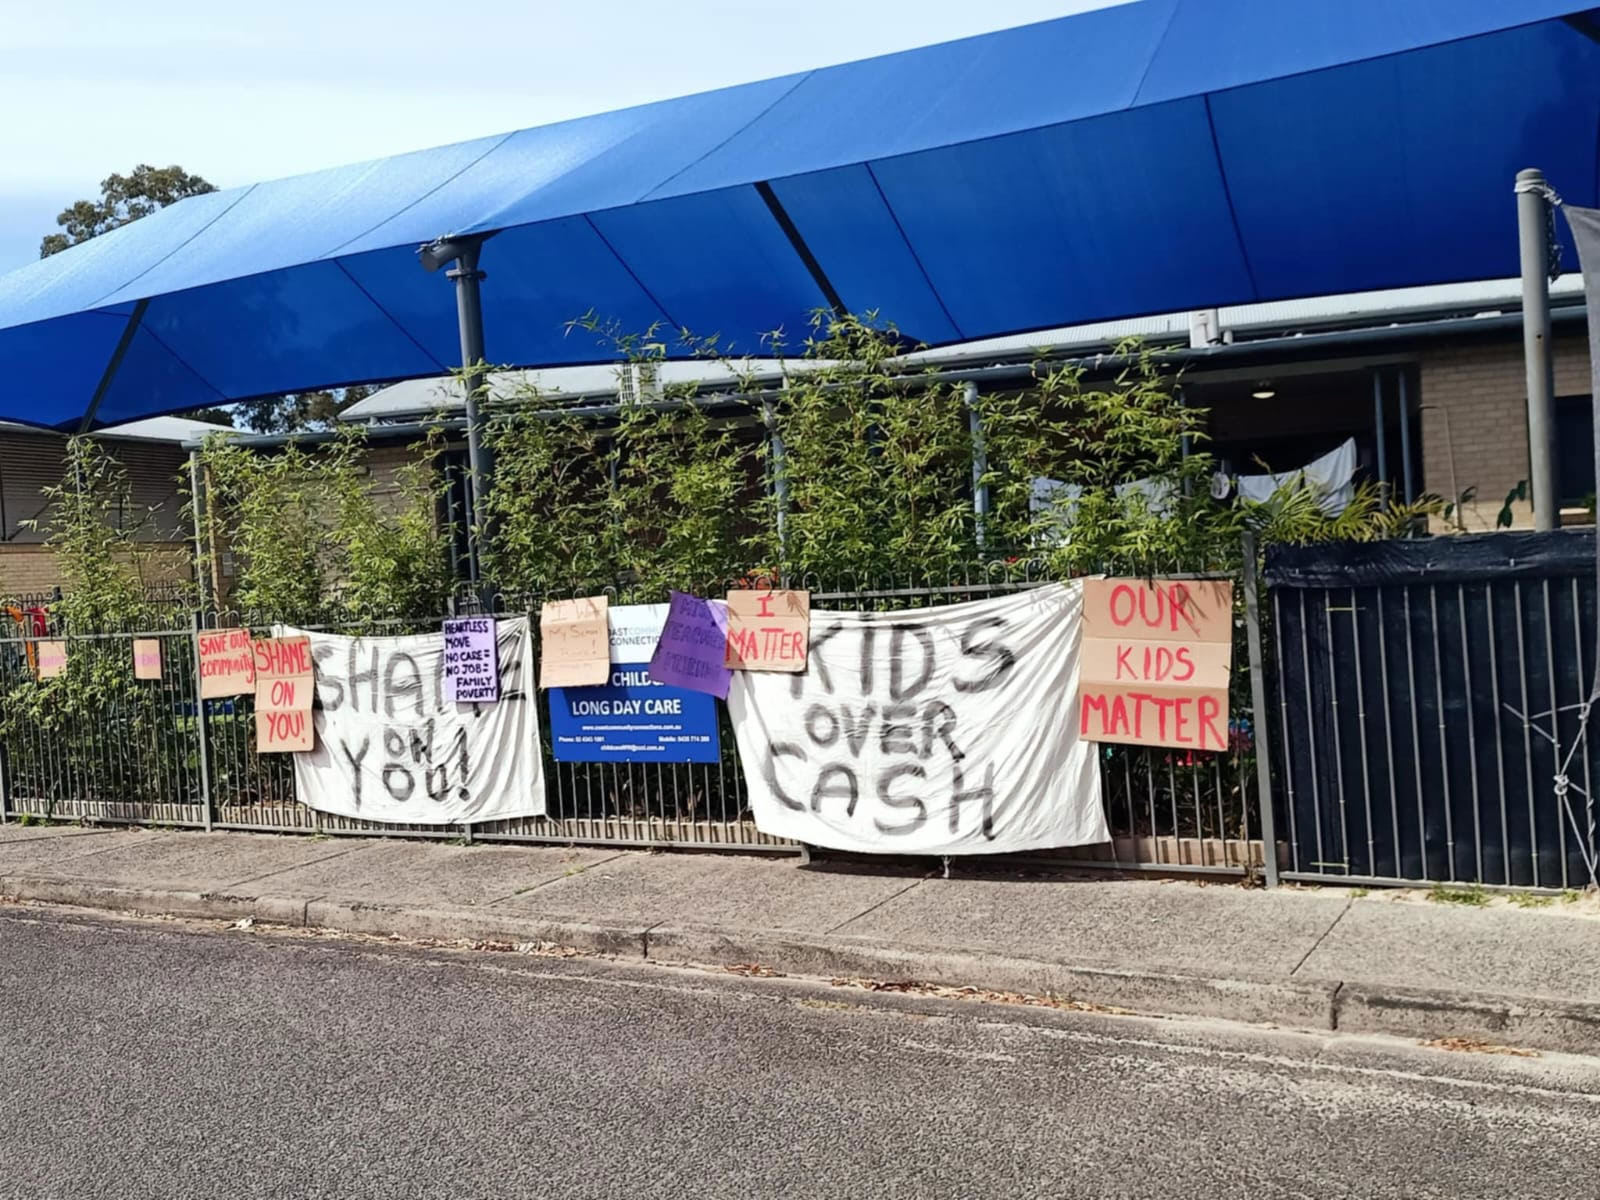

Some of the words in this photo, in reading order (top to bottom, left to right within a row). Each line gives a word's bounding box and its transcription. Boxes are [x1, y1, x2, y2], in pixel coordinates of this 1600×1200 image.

[756, 596, 775, 618] I
[1109, 583, 1201, 635] OUR
[200, 634, 228, 656] SAVE
[230, 630, 252, 649] OUR
[444, 620, 488, 635] HEARTLESS
[445, 636, 471, 650] MOVE
[256, 641, 312, 675] SHAME
[445, 652, 459, 663] NO
[460, 650, 483, 661] CARE
[725, 628, 805, 662] MATTER
[790, 615, 1016, 701] KIDS
[446, 665, 460, 678] NO
[461, 663, 481, 674] JOB
[1115, 644, 1196, 682] KIDS
[271, 680, 295, 707] ON
[456, 676, 492, 688] FAMILY
[456, 686, 496, 700] POVERTY
[572, 701, 610, 715] LONG
[613, 700, 641, 715] DAY
[644, 699, 682, 714] CARE
[1081, 692, 1226, 749] MATTER
[266, 711, 306, 744] YOU!
[383, 718, 436, 764] ON
[804, 700, 965, 760] OVER
[340, 726, 471, 813] YOU!
[763, 741, 996, 840] CASH
